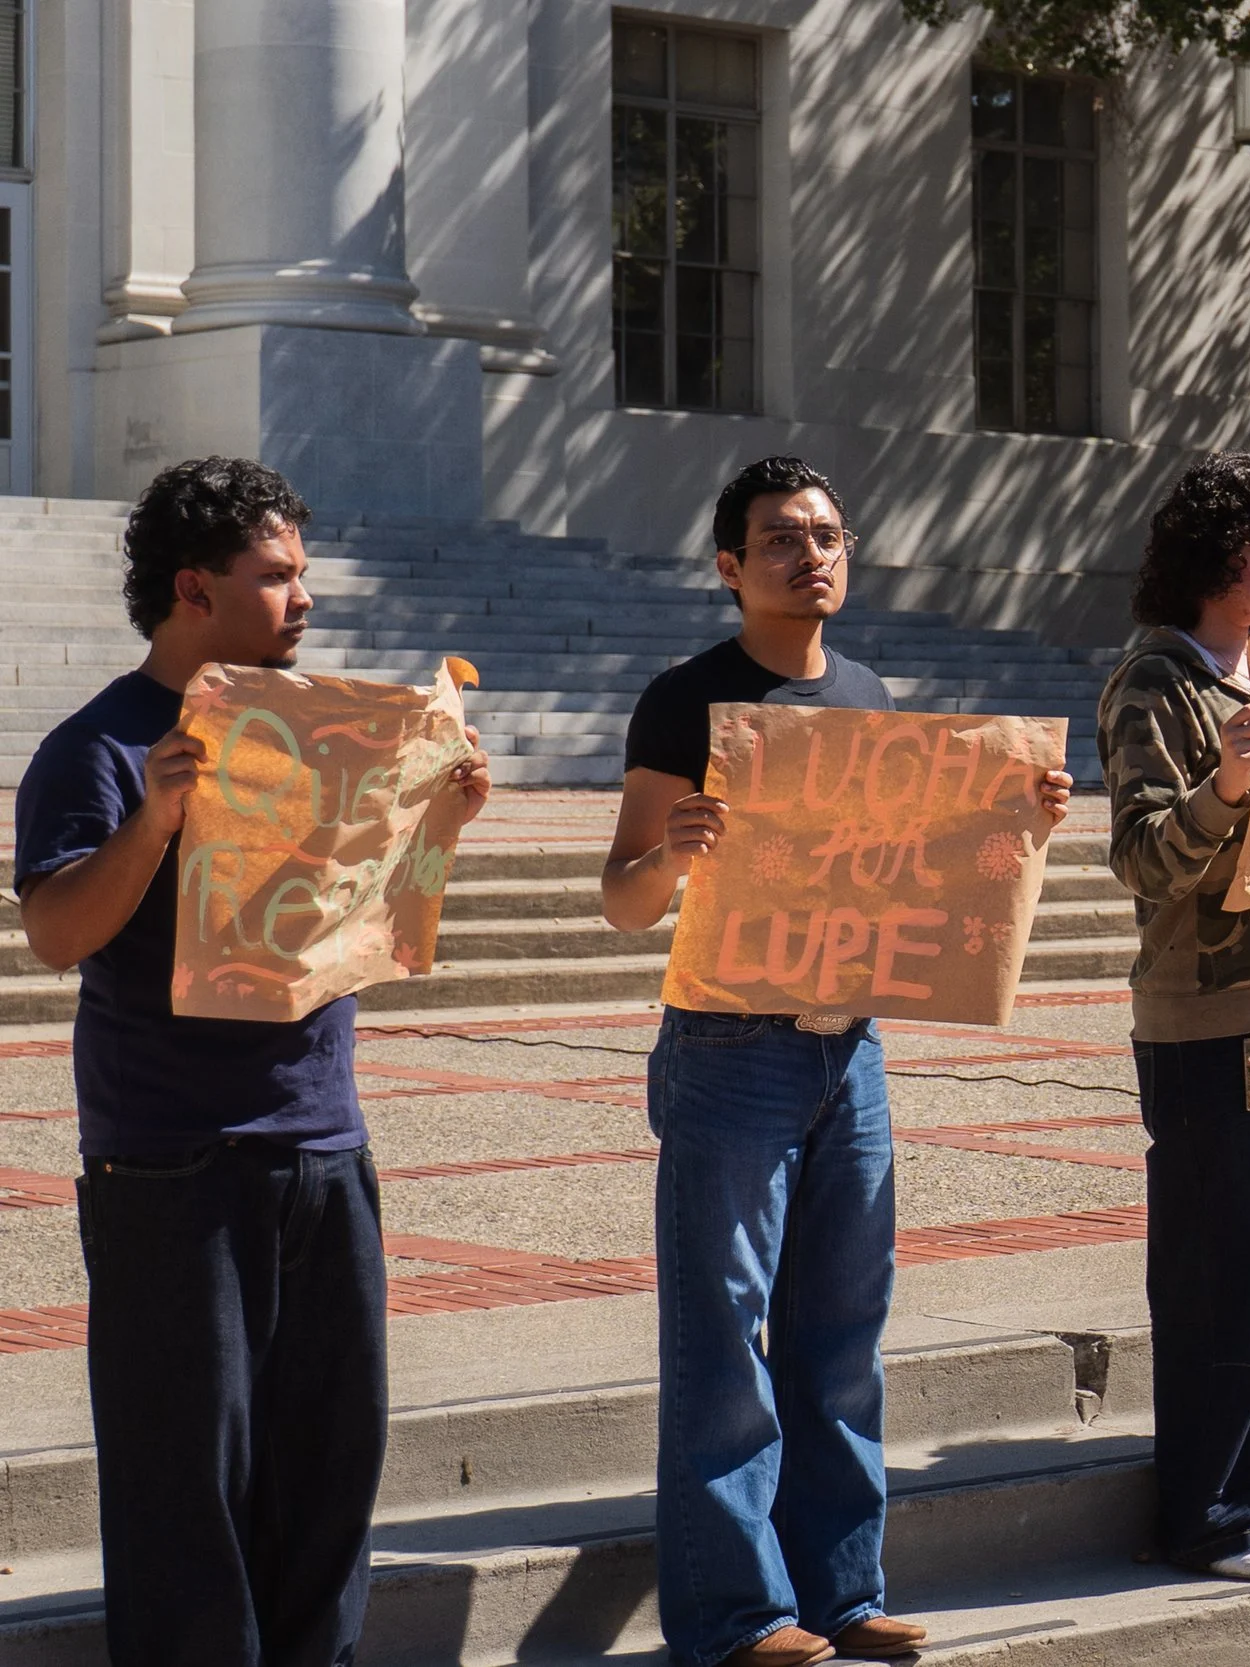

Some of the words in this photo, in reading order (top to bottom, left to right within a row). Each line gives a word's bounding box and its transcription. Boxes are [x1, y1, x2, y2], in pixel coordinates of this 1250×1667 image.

[746, 723, 1037, 821] LUCHA
[715, 907, 949, 1000] LUPE
[815, 1015, 842, 1024] ARIAT
